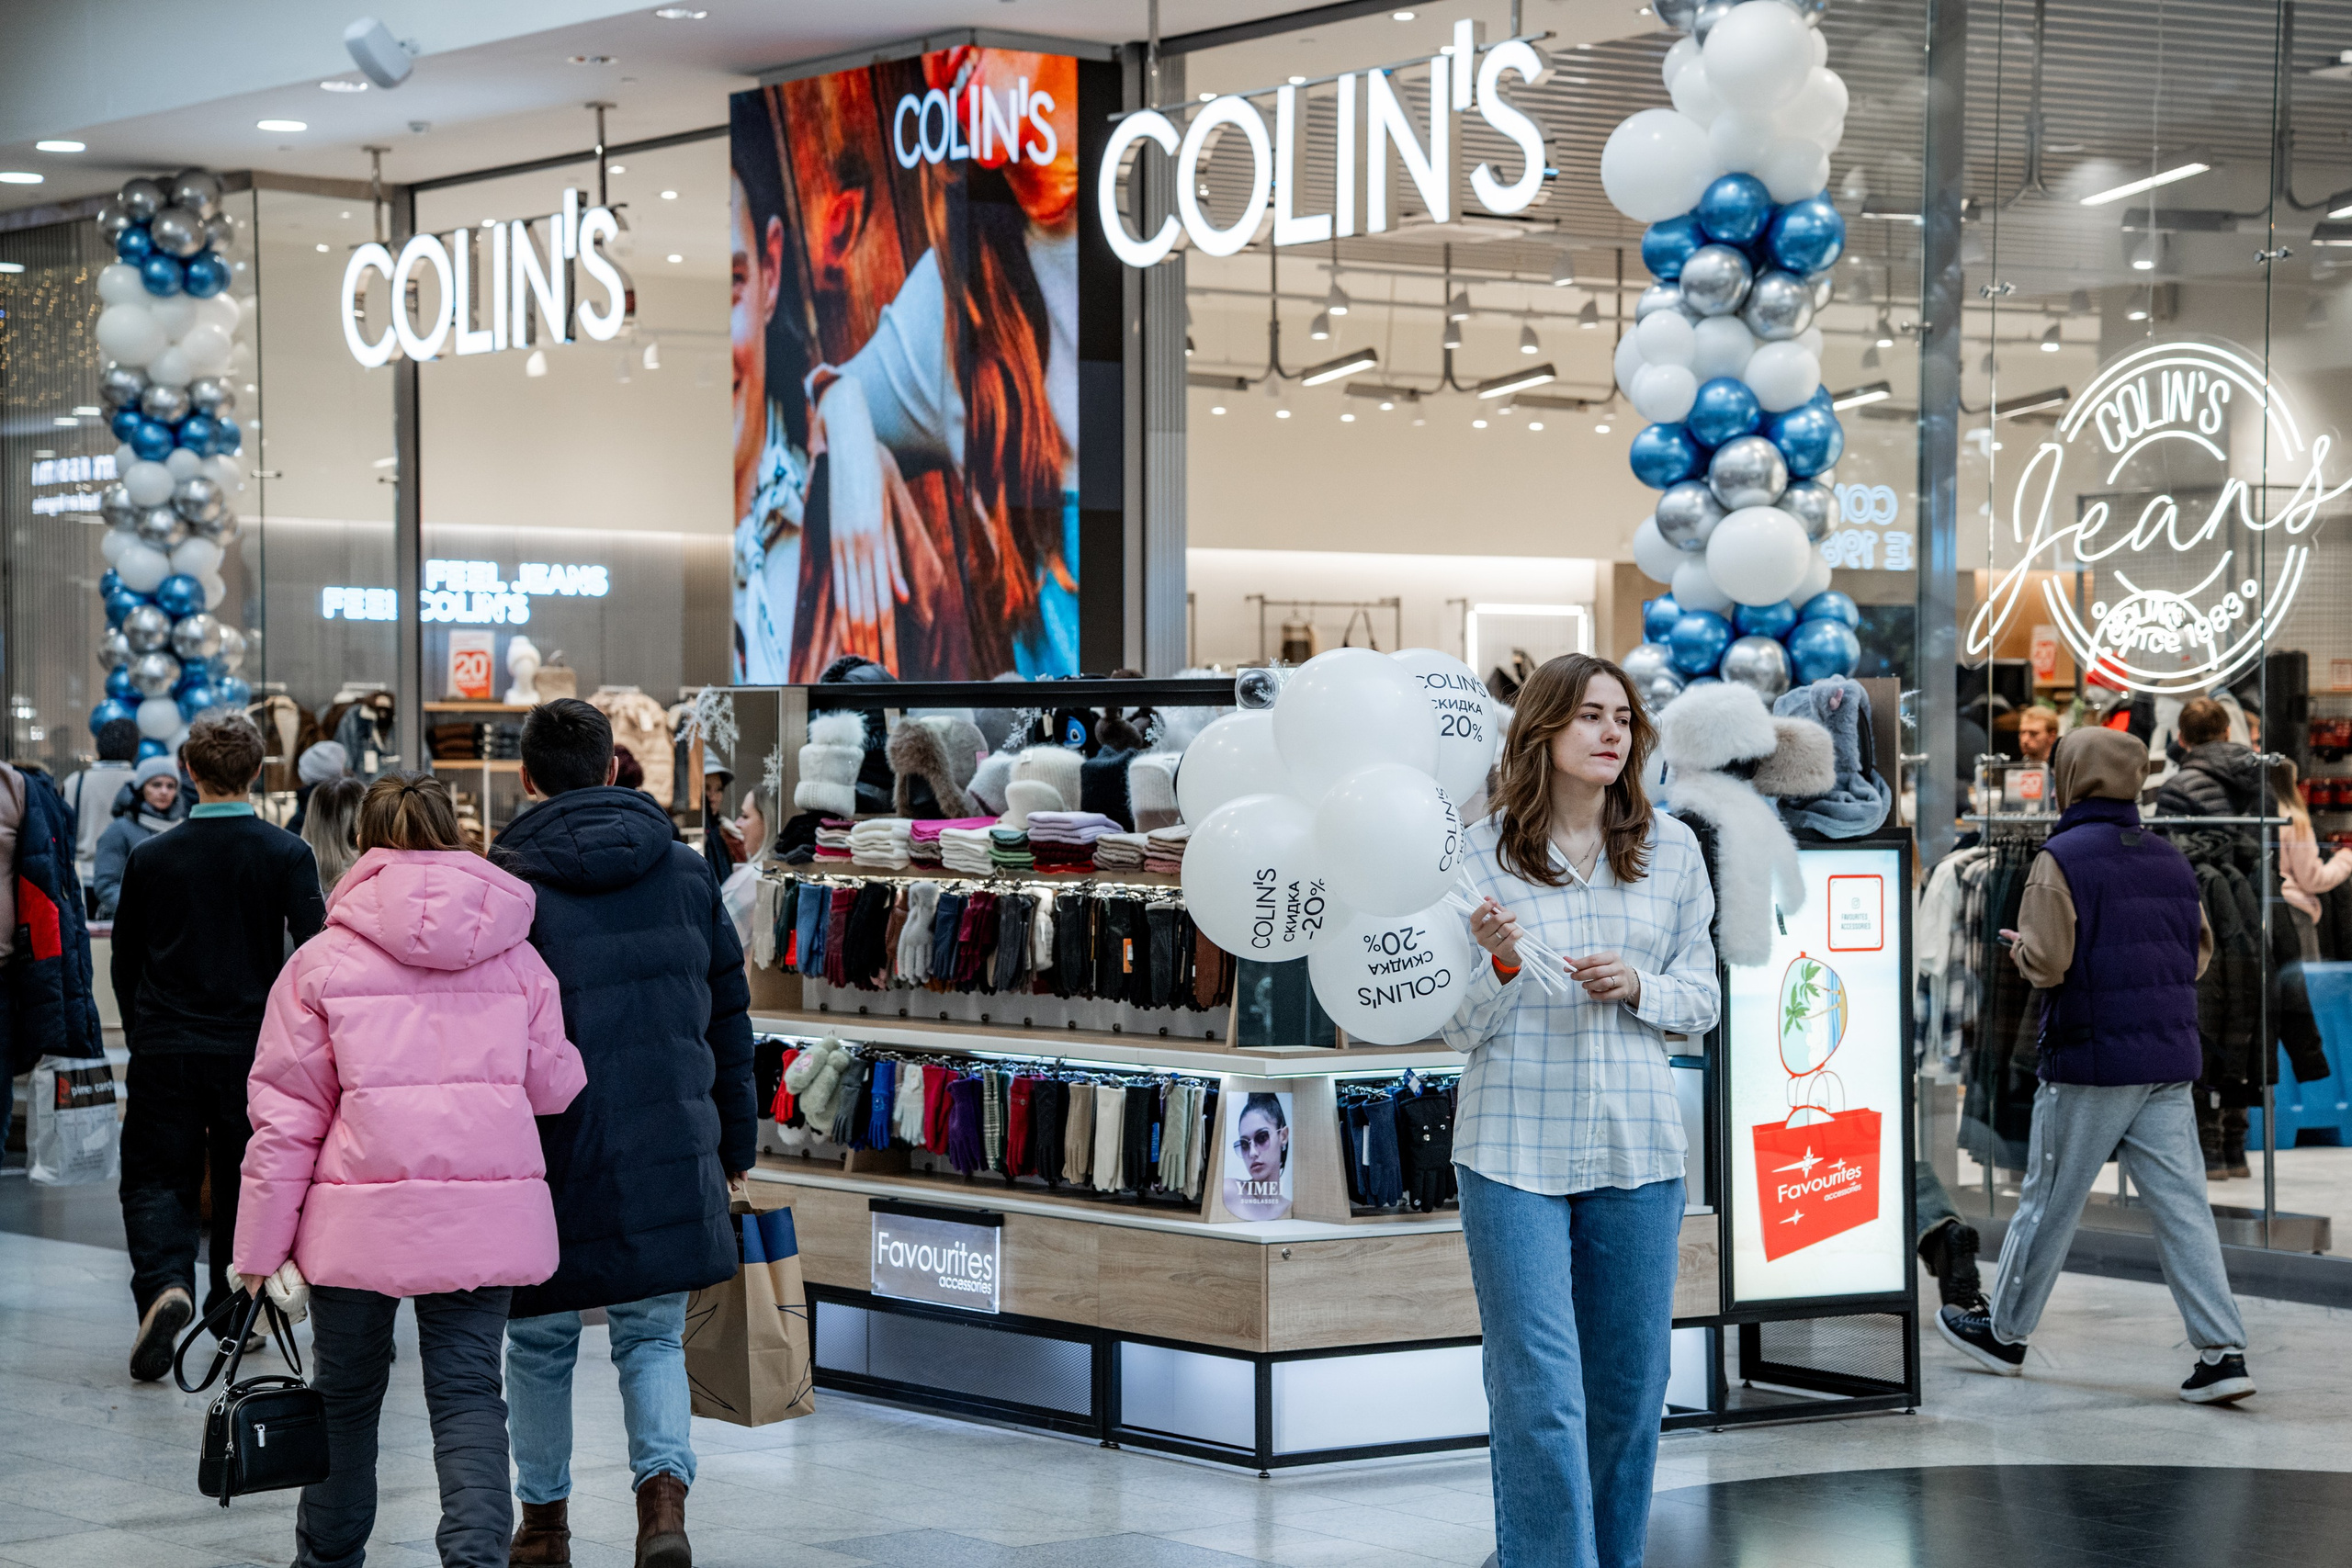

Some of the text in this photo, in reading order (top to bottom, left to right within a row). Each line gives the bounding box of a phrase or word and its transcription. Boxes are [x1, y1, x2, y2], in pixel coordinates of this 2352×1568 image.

[893, 75, 1057, 169] COLIN'S
[1099, 18, 1545, 267] COLIN'S
[342, 187, 627, 367] COLIN'S
[2096, 370, 2230, 453] COLIN'S
[1967, 434, 2352, 655] Jeans
[425, 559, 609, 597] FEEL JEANS
[2183, 592, 2245, 648] 1983
[1436, 787, 1457, 872] COLIN'S
[1251, 868, 1276, 949] COLIN'S
[1283, 880, 1301, 942] СКИДКА
[1302, 878, 1326, 940] -20%
[1363, 926, 1426, 955] -20%
[1367, 951, 1434, 976] СКИДКА
[1357, 969, 1451, 1009] COLIN'S
[1777, 1166, 1862, 1203] Favourites
[878, 1232, 993, 1280] Favourites
[938, 1275, 992, 1294] accessories
